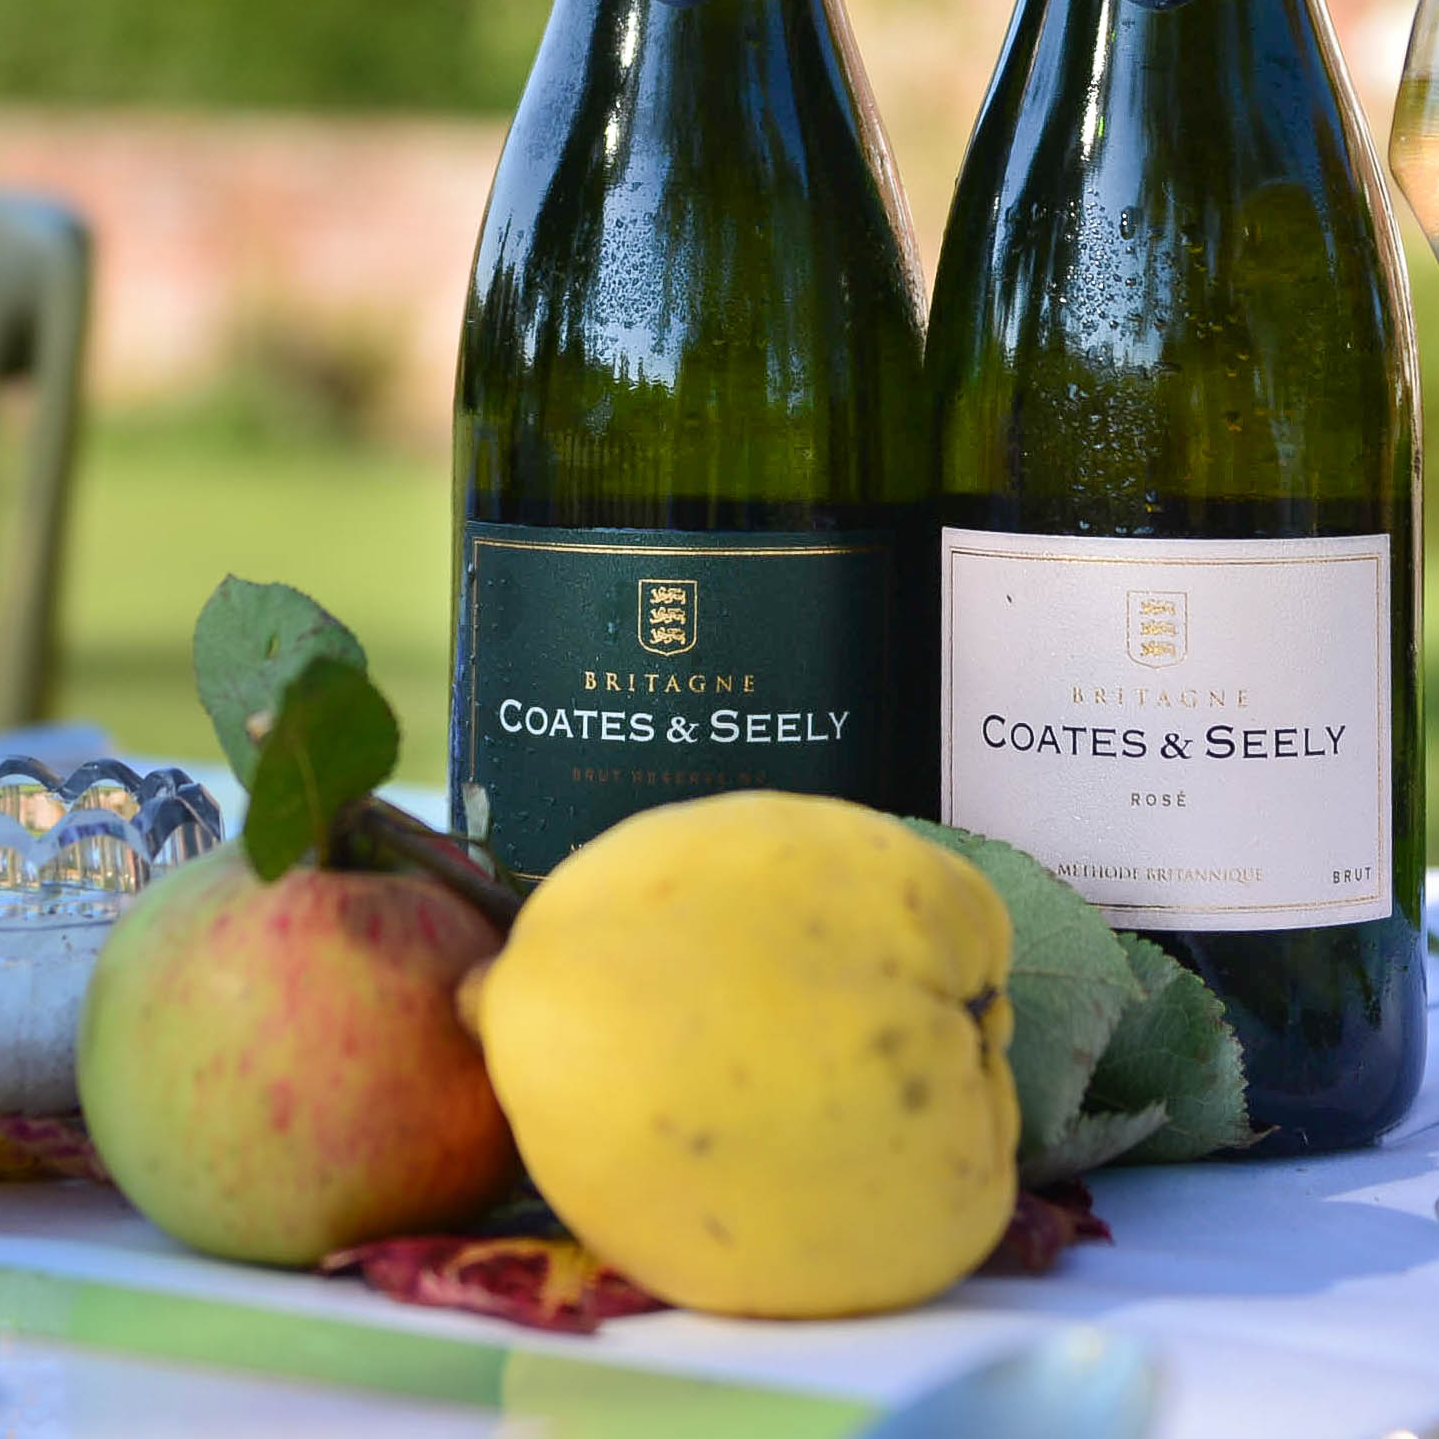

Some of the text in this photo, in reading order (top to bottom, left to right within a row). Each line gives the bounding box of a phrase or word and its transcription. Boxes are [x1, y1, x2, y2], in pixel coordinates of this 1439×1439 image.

[583, 670, 757, 694] BRITAGNE
[1072, 686, 1250, 709] BRITAGNE
[499, 698, 851, 744] COATES & SEELY
[982, 714, 1347, 760] COATES & SEELY
[1130, 790, 1188, 808] ROSÉ
[1332, 865, 1372, 884] BRUT
